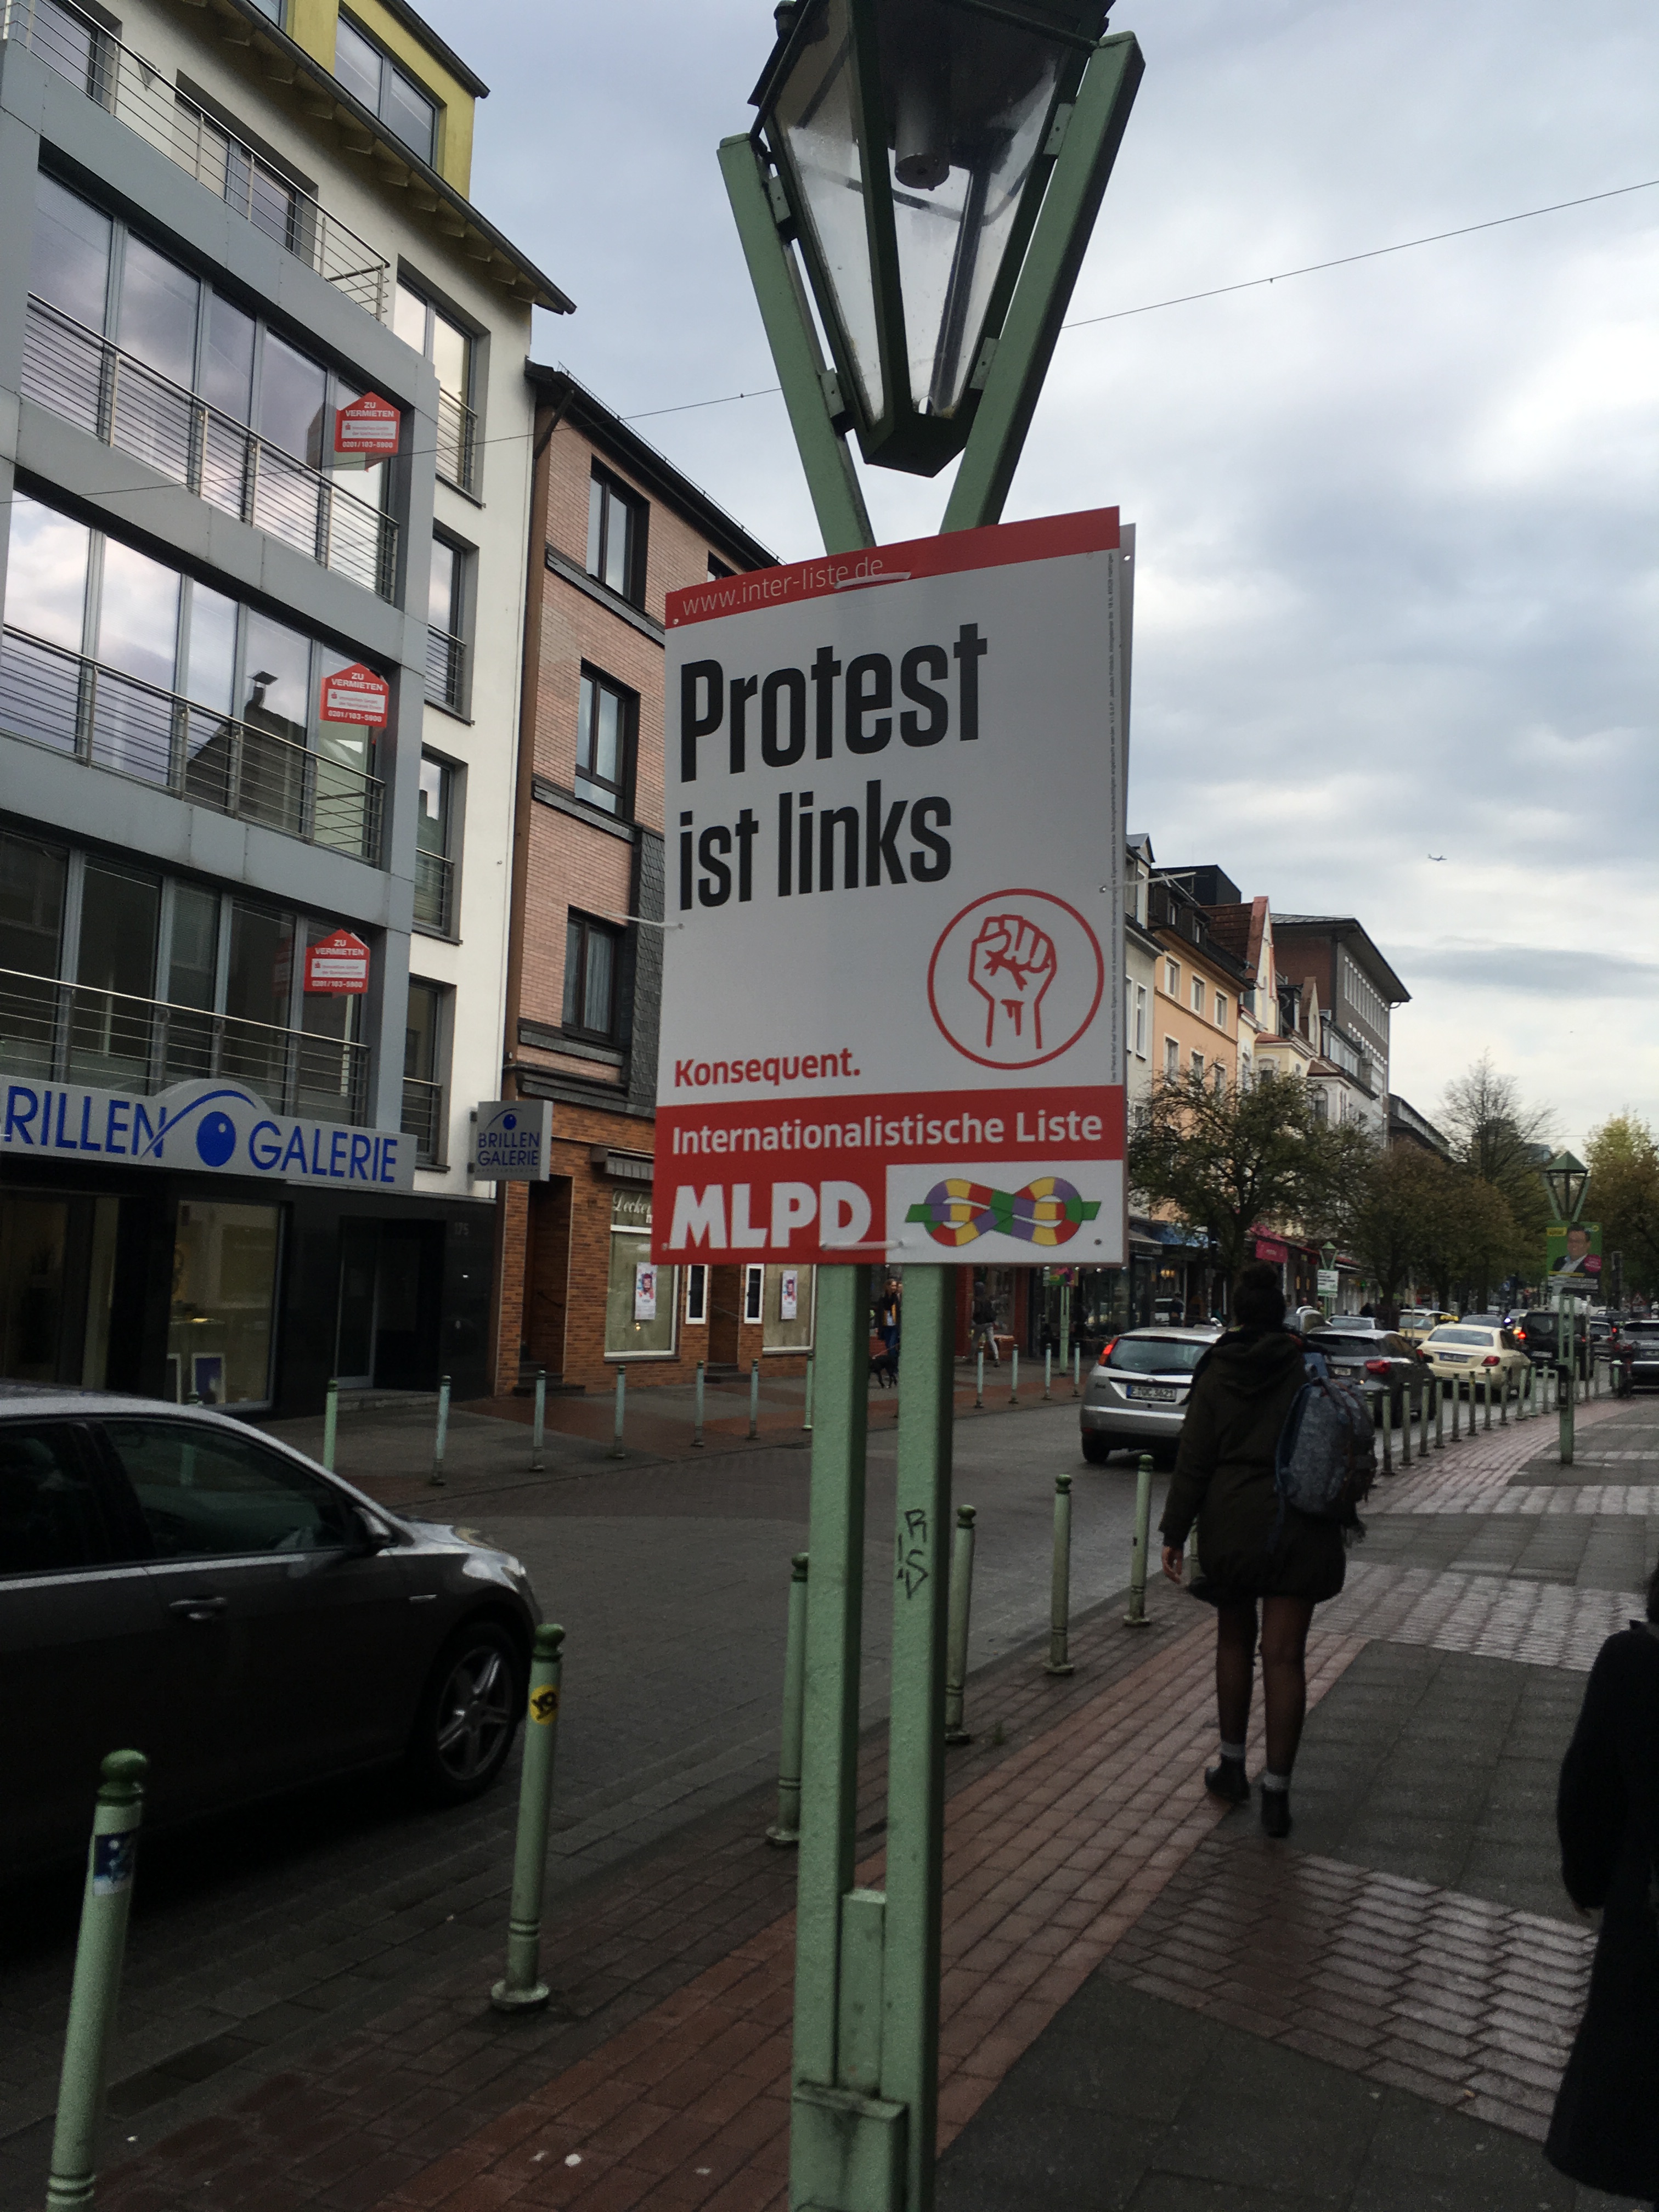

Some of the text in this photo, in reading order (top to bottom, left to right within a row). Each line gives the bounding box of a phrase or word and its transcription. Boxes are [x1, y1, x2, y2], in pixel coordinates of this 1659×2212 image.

[683, 557, 883, 615] www.inter-listede
[331, 678, 383, 691] VERMIETEN
[352, 672, 364, 680] ZU
[681, 623, 988, 783] Protest
[680, 780, 952, 911] ist links
[315, 947, 364, 956] VERMIETEN
[674, 1048, 861, 1087] Konsequent.
[249, 1120, 398, 1183] GALERIE
[478, 1132, 540, 1148] BRILLEN
[673, 1110, 1103, 1155] Internationalistische Liste
[477, 1150, 539, 1166] GALERIE
[669, 1180, 872, 1249] MLPD
